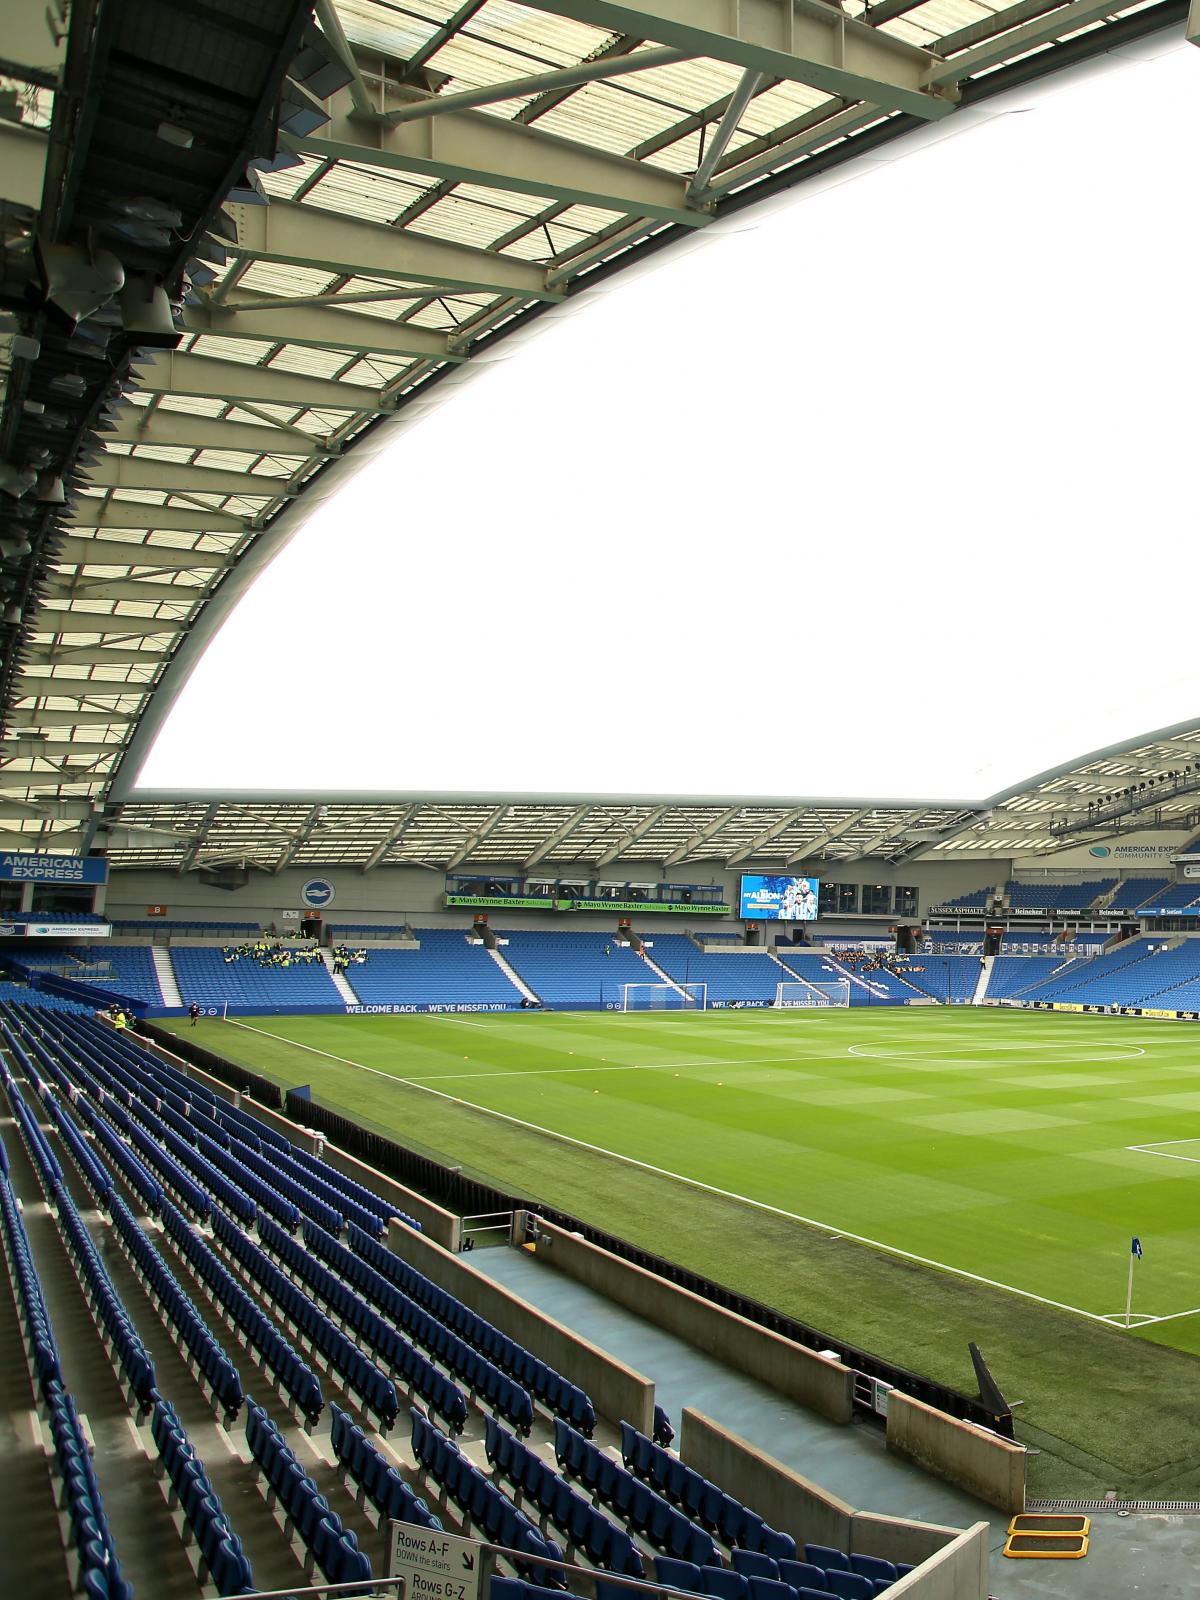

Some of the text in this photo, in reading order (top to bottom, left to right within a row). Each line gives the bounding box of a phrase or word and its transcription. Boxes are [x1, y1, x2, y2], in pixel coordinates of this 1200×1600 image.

[3, 856, 84, 869] AMERICAN
[12, 867, 84, 880] EXPRESS
[478, 897, 501, 905] Wynne
[346, 1005, 392, 1014] WELCOME
[429, 1004, 456, 1013] WE'VE
[457, 1004, 489, 1012] MISSED
[397, 1531, 450, 1556] Rows A-F
[396, 1548, 451, 1571] DOWN the stairs
[413, 1574, 465, 1600] Rows G-Z
